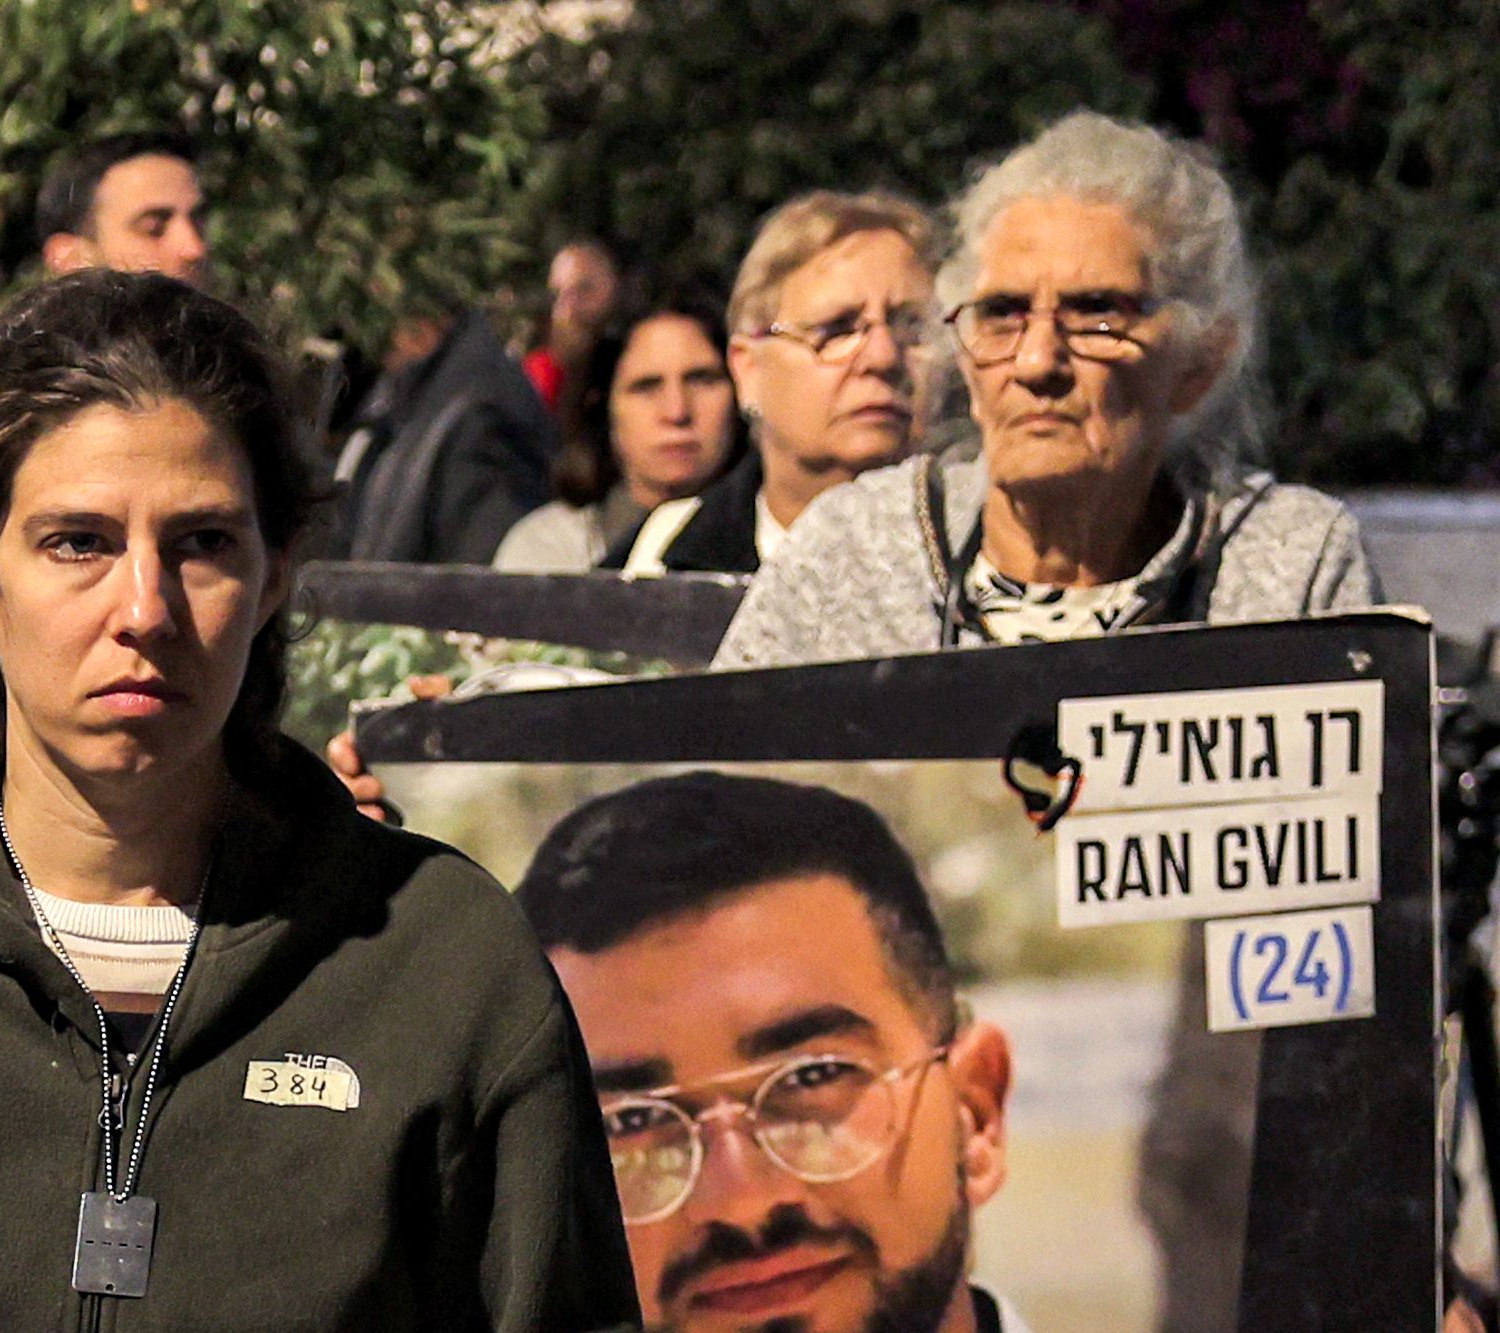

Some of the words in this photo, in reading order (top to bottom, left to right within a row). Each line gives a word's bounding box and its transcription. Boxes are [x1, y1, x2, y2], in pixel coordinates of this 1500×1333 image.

[1089, 711, 1282, 788] גואילי
[1306, 708, 1363, 788] רן
[1076, 830, 1193, 904] RAN
[1216, 815, 1359, 892] GVILI
[1229, 922, 1355, 1021] (24)
